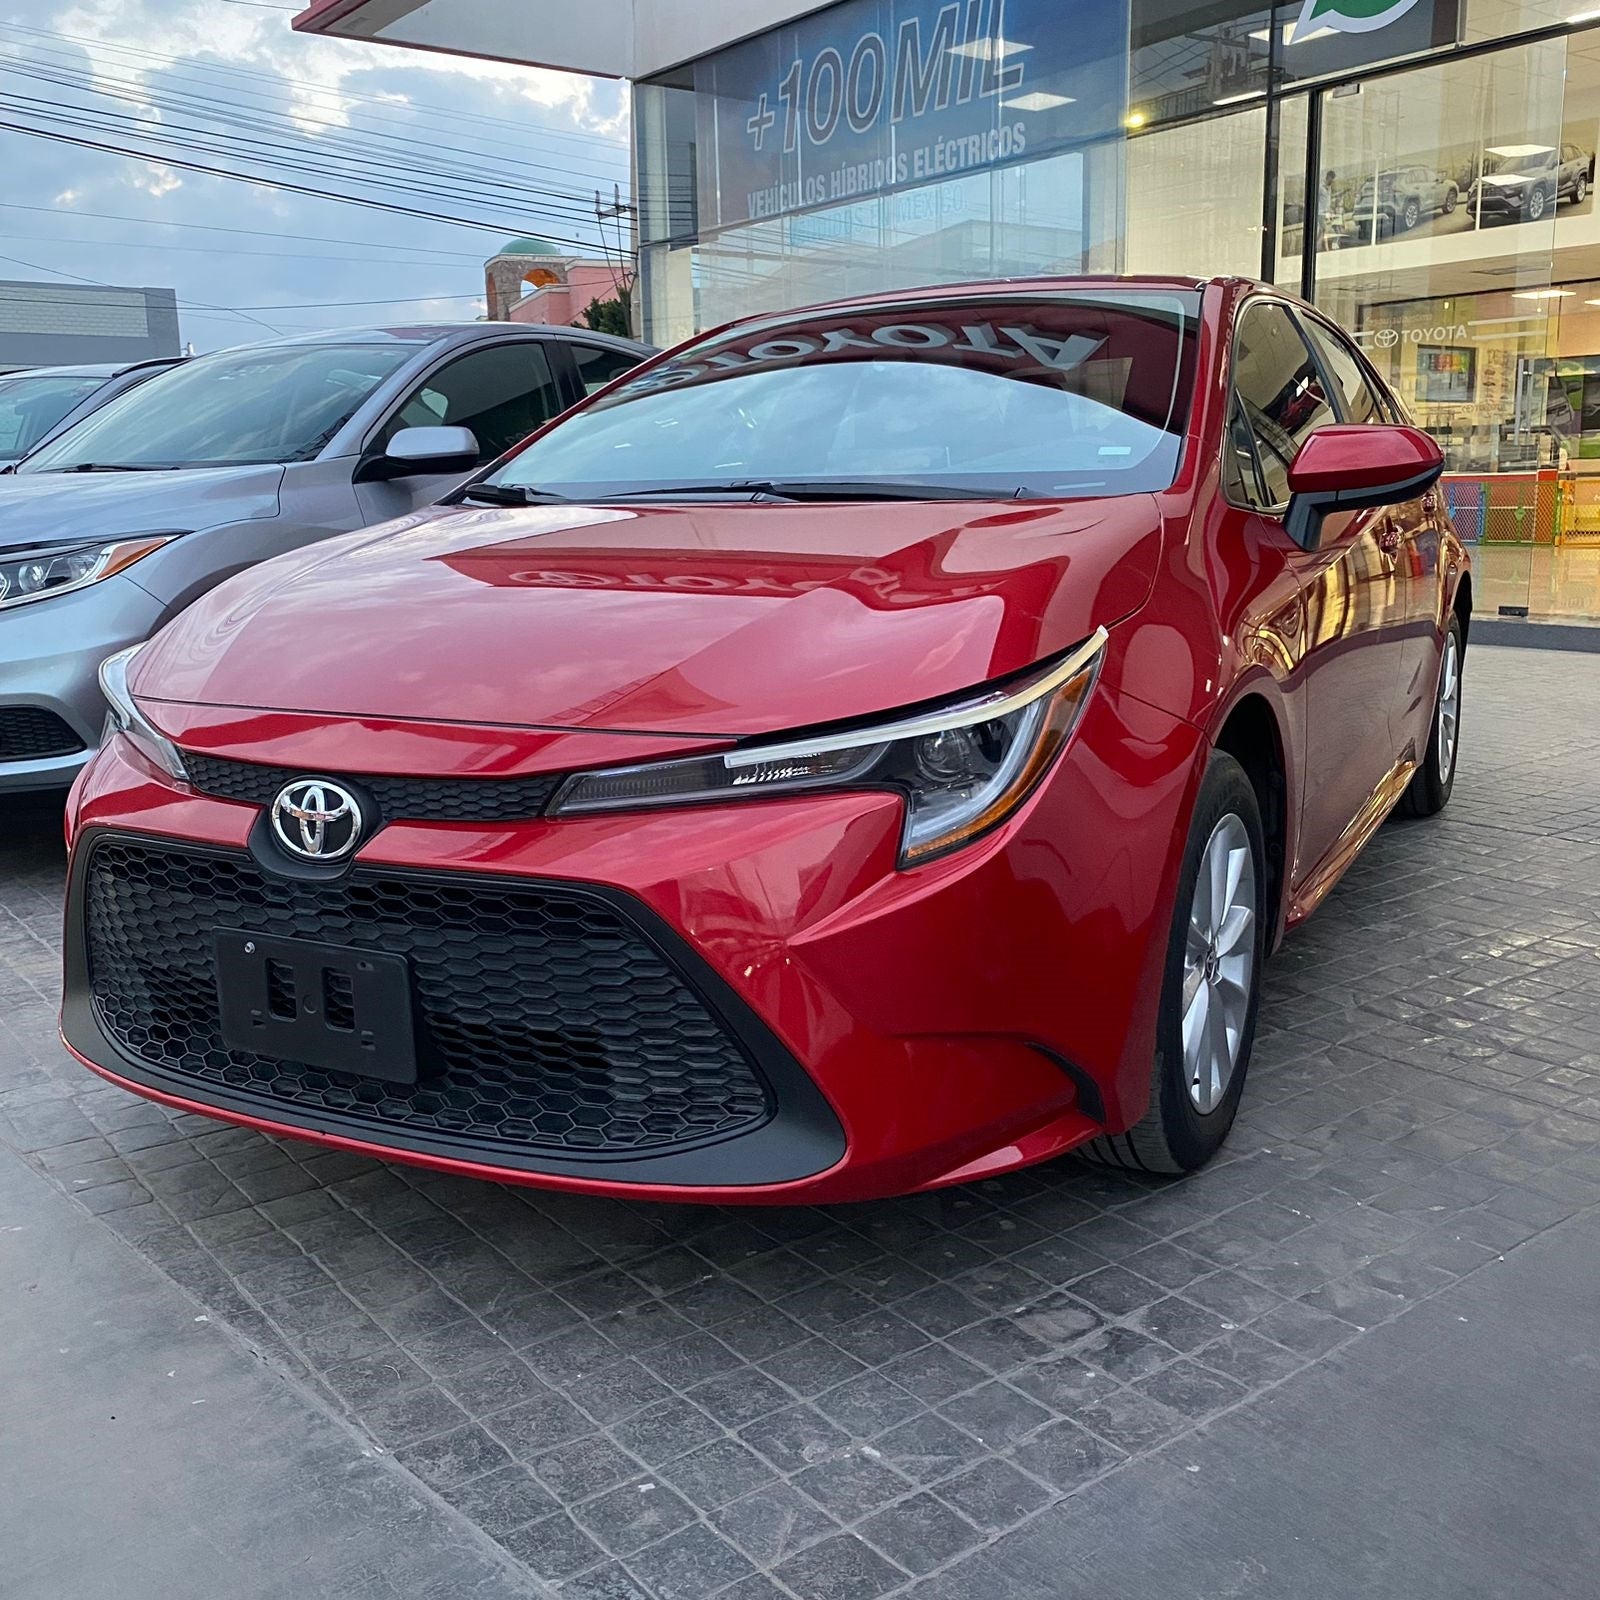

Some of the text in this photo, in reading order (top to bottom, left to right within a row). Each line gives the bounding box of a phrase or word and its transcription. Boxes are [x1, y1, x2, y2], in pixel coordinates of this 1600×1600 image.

[830, 156, 908, 198] HÍBRIDOS
[913, 122, 1027, 179] ELÉCTRICOS
[1401, 324, 1467, 343] TOYOTA
